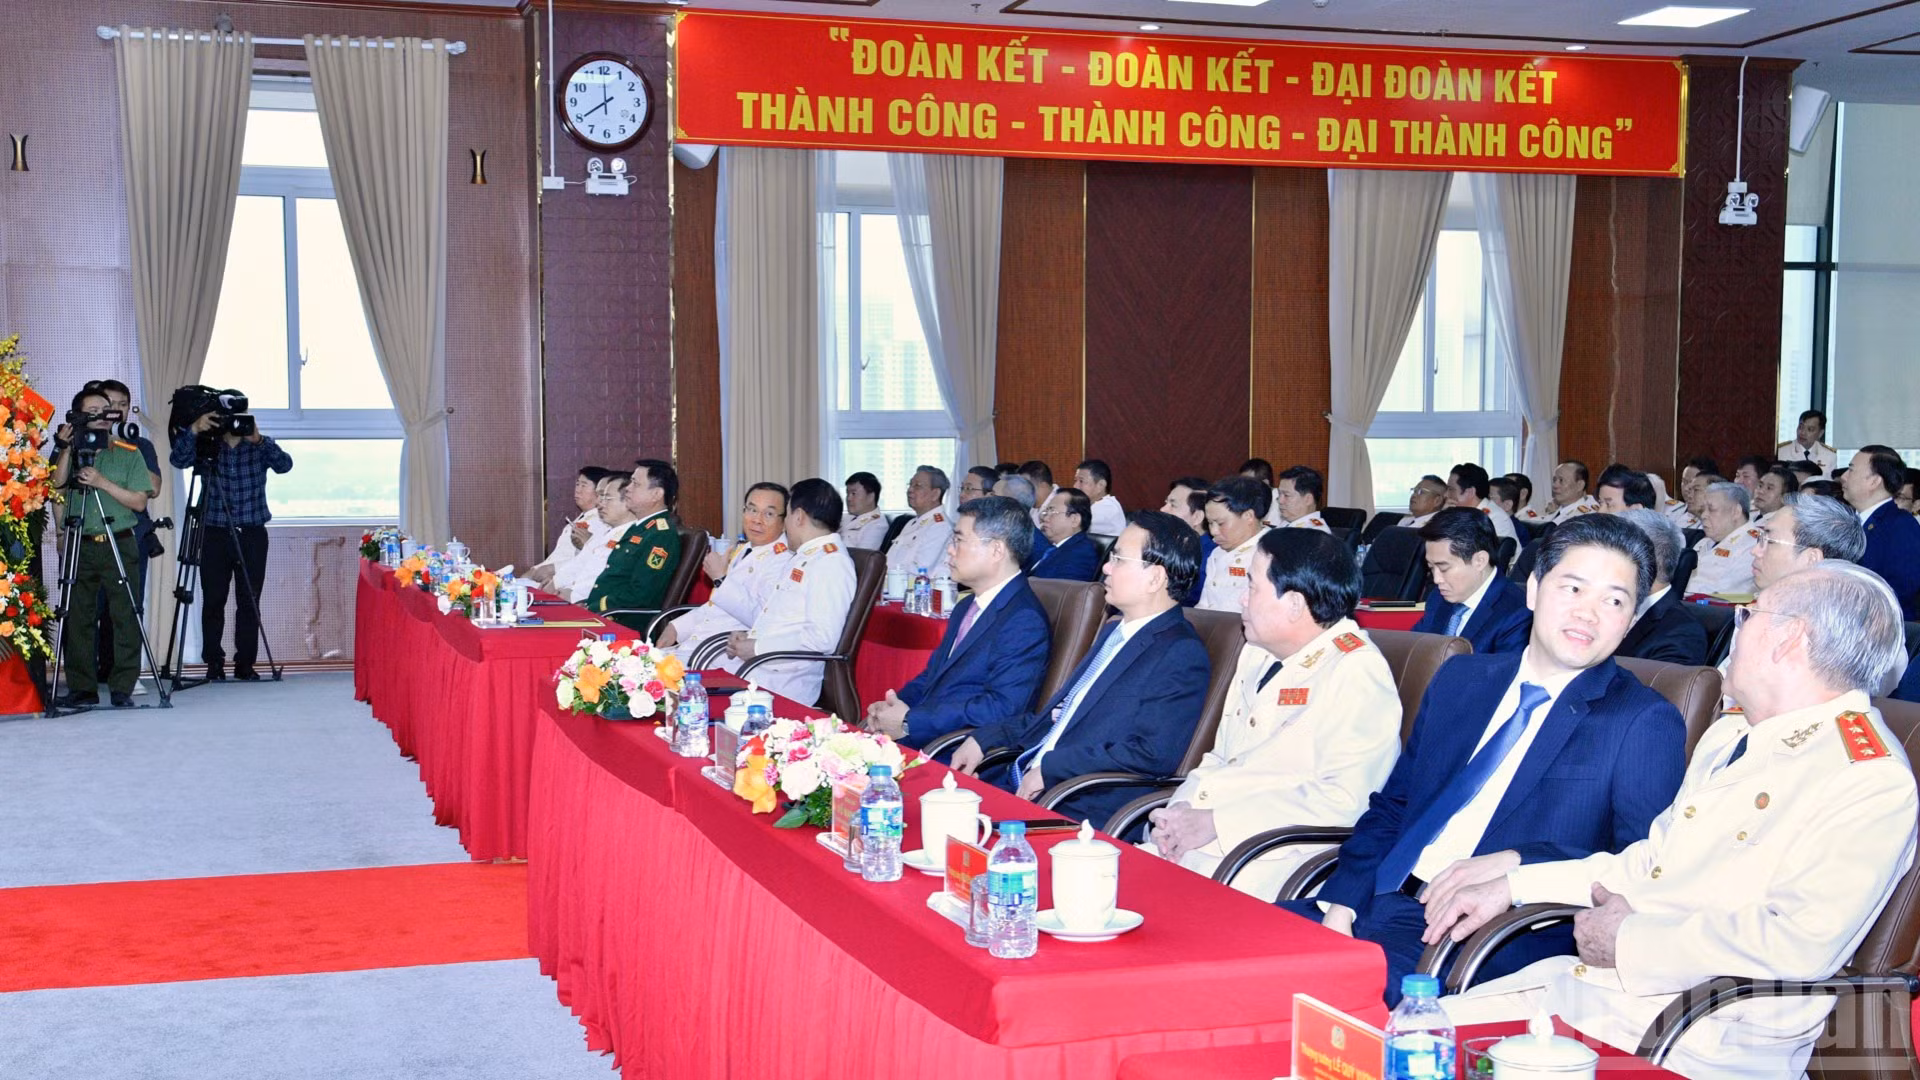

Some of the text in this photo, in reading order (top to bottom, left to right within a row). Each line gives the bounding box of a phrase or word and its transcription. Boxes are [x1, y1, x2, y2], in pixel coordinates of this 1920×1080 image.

[598, 66, 610, 76] 12
[977, 35, 1049, 84] KẾT
[1087, 46, 1193, 91] ĐOÀN
[1207, 47, 1274, 94] KẾT
[1311, 62, 1372, 104] ĐẠI
[1383, 59, 1482, 102] ĐOÀN
[1494, 57, 1558, 105] KẾT
[617, 71, 622, 80] 1
[574, 83, 587, 93] 10
[628, 82, 635, 92] 2
[570, 98, 578, 107] 9
[633, 98, 641, 107] 3
[576, 114, 584, 123] 8
[629, 114, 636, 123] 4
[736, 86, 873, 134] THÀNH
[888, 92, 997, 140] CÔNG
[1038, 100, 1166, 146] THÀNH
[1179, 105, 1281, 149] CÔNG
[1316, 117, 1378, 160] ĐẠI
[1389, 114, 1507, 157] THÀNH
[588, 125, 595, 134] 7
[603, 129, 611, 138] 6
[619, 125, 626, 134] 5
